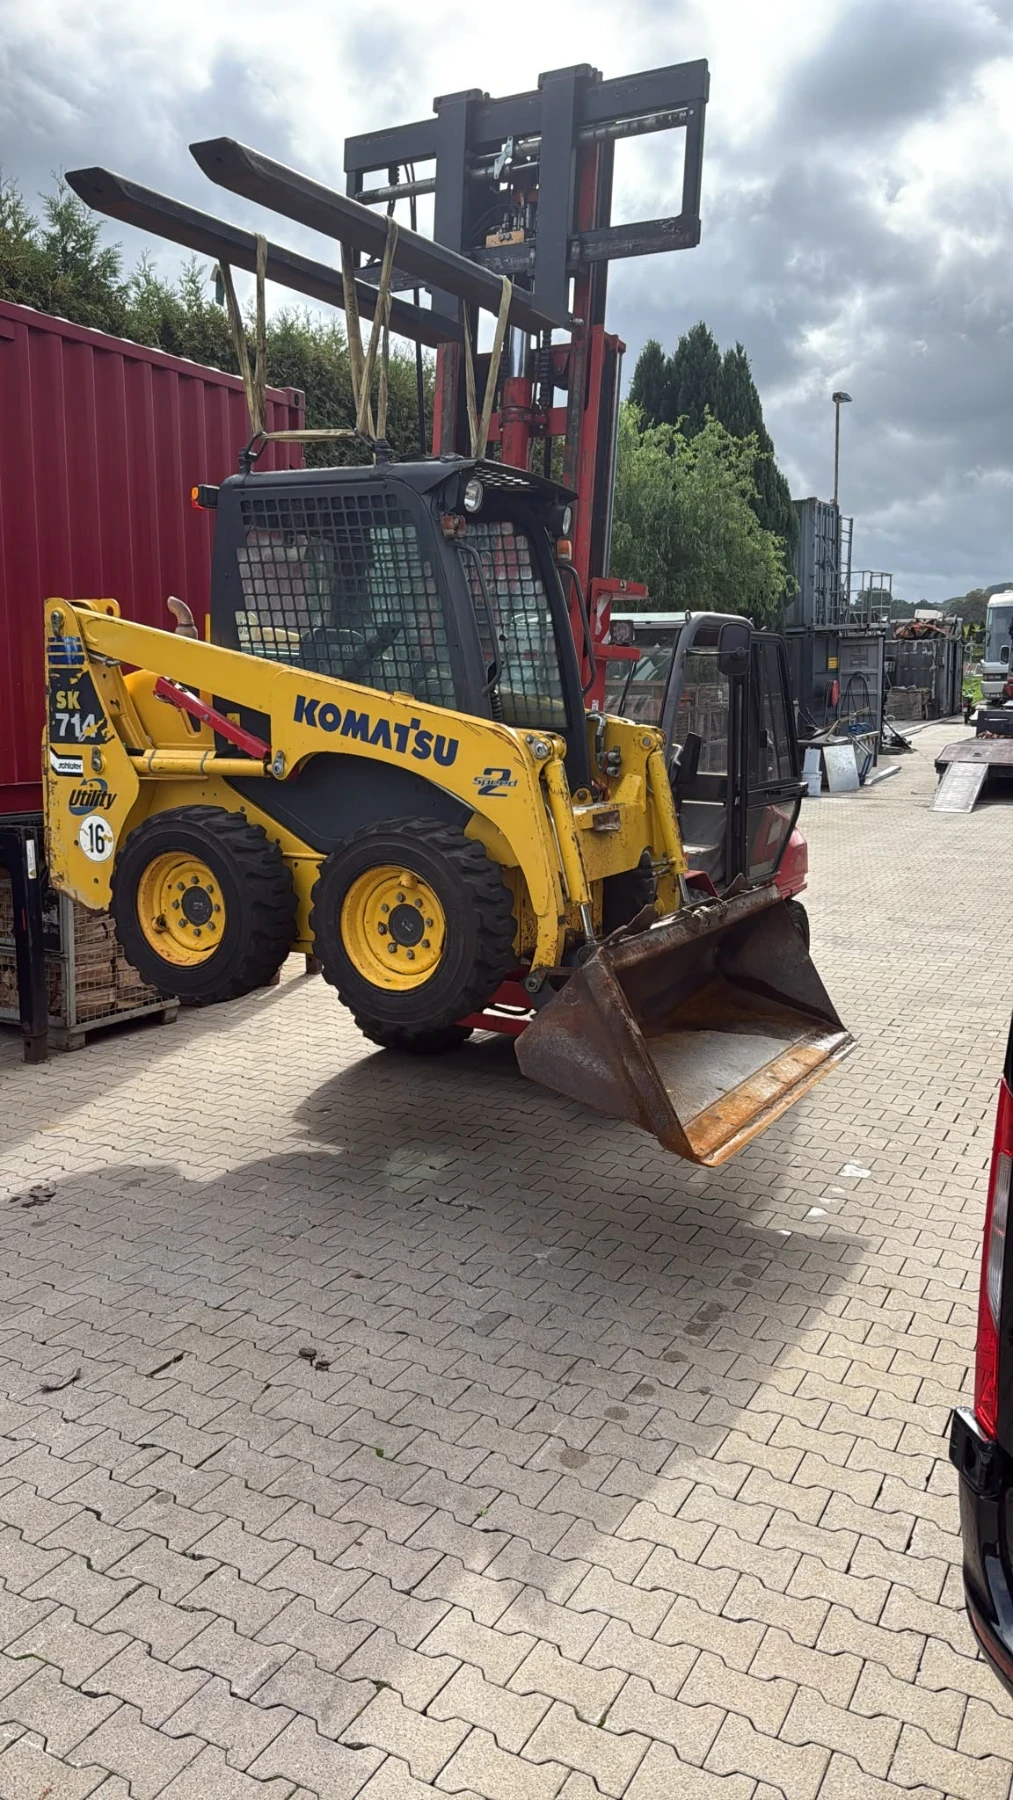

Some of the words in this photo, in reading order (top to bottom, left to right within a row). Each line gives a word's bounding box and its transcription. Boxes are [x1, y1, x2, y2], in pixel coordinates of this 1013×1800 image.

[56, 690, 81, 710] SK
[55, 713, 97, 739] 714
[293, 694, 459, 767] KOMATSU
[69, 789, 118, 810] Utility
[88, 823, 105, 854] 16
